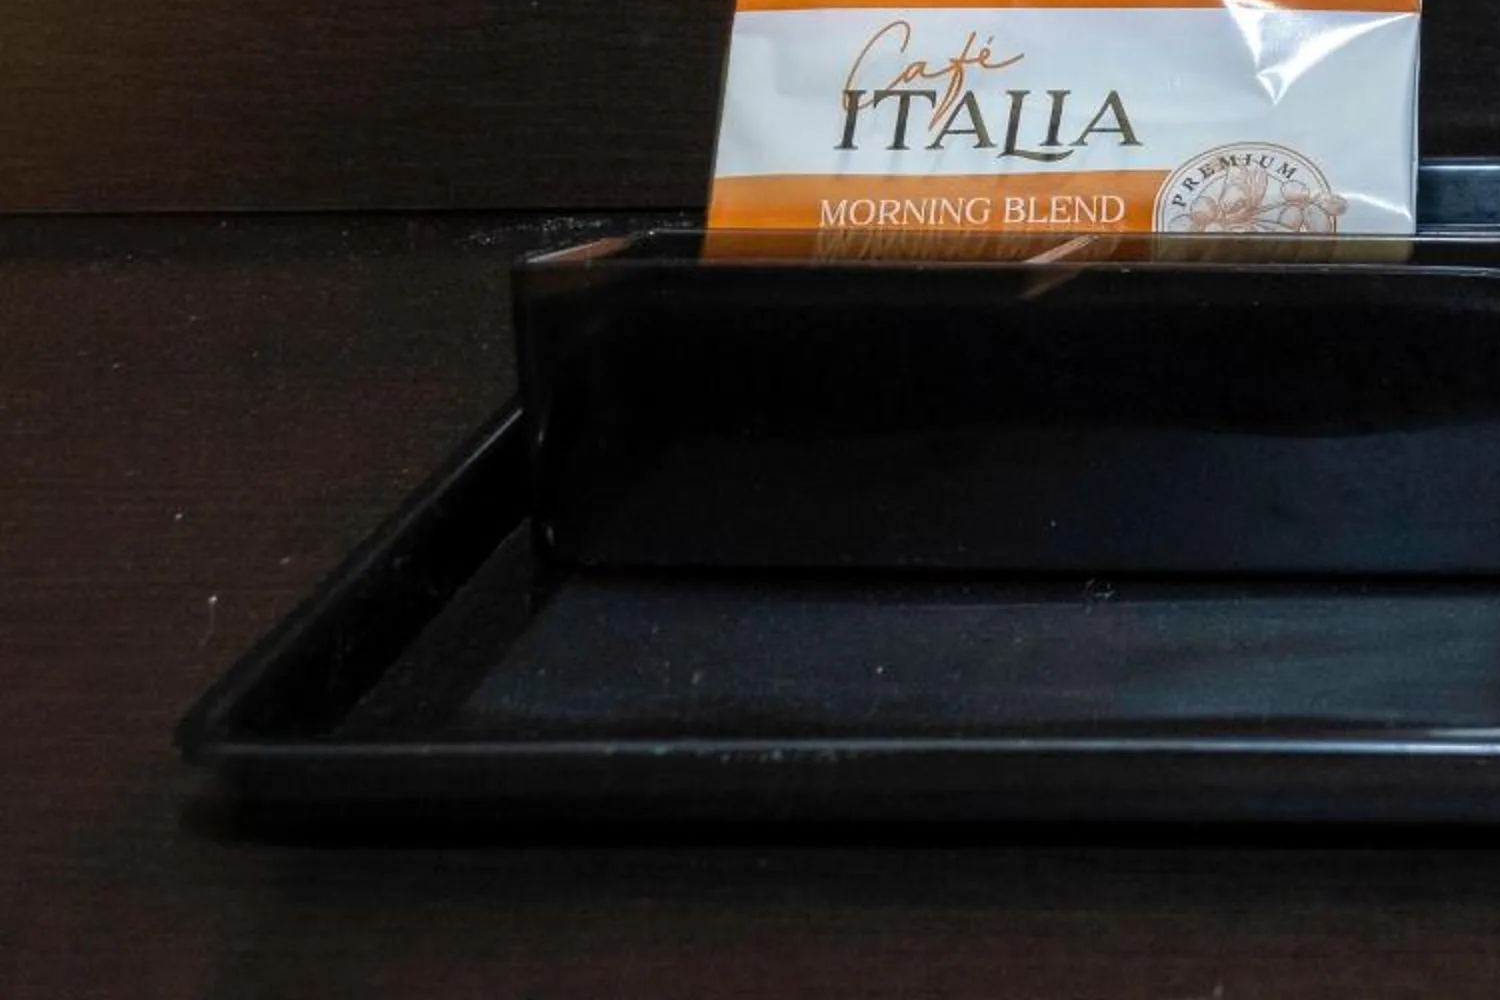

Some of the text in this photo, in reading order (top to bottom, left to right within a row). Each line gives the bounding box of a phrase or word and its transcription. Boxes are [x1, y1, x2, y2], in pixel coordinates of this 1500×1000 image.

[842, 19, 1025, 131] Café
[833, 88, 1144, 162] ITALIA
[818, 194, 1126, 228] MORNING BLEND
[1171, 153, 1298, 208] PREMIUM
